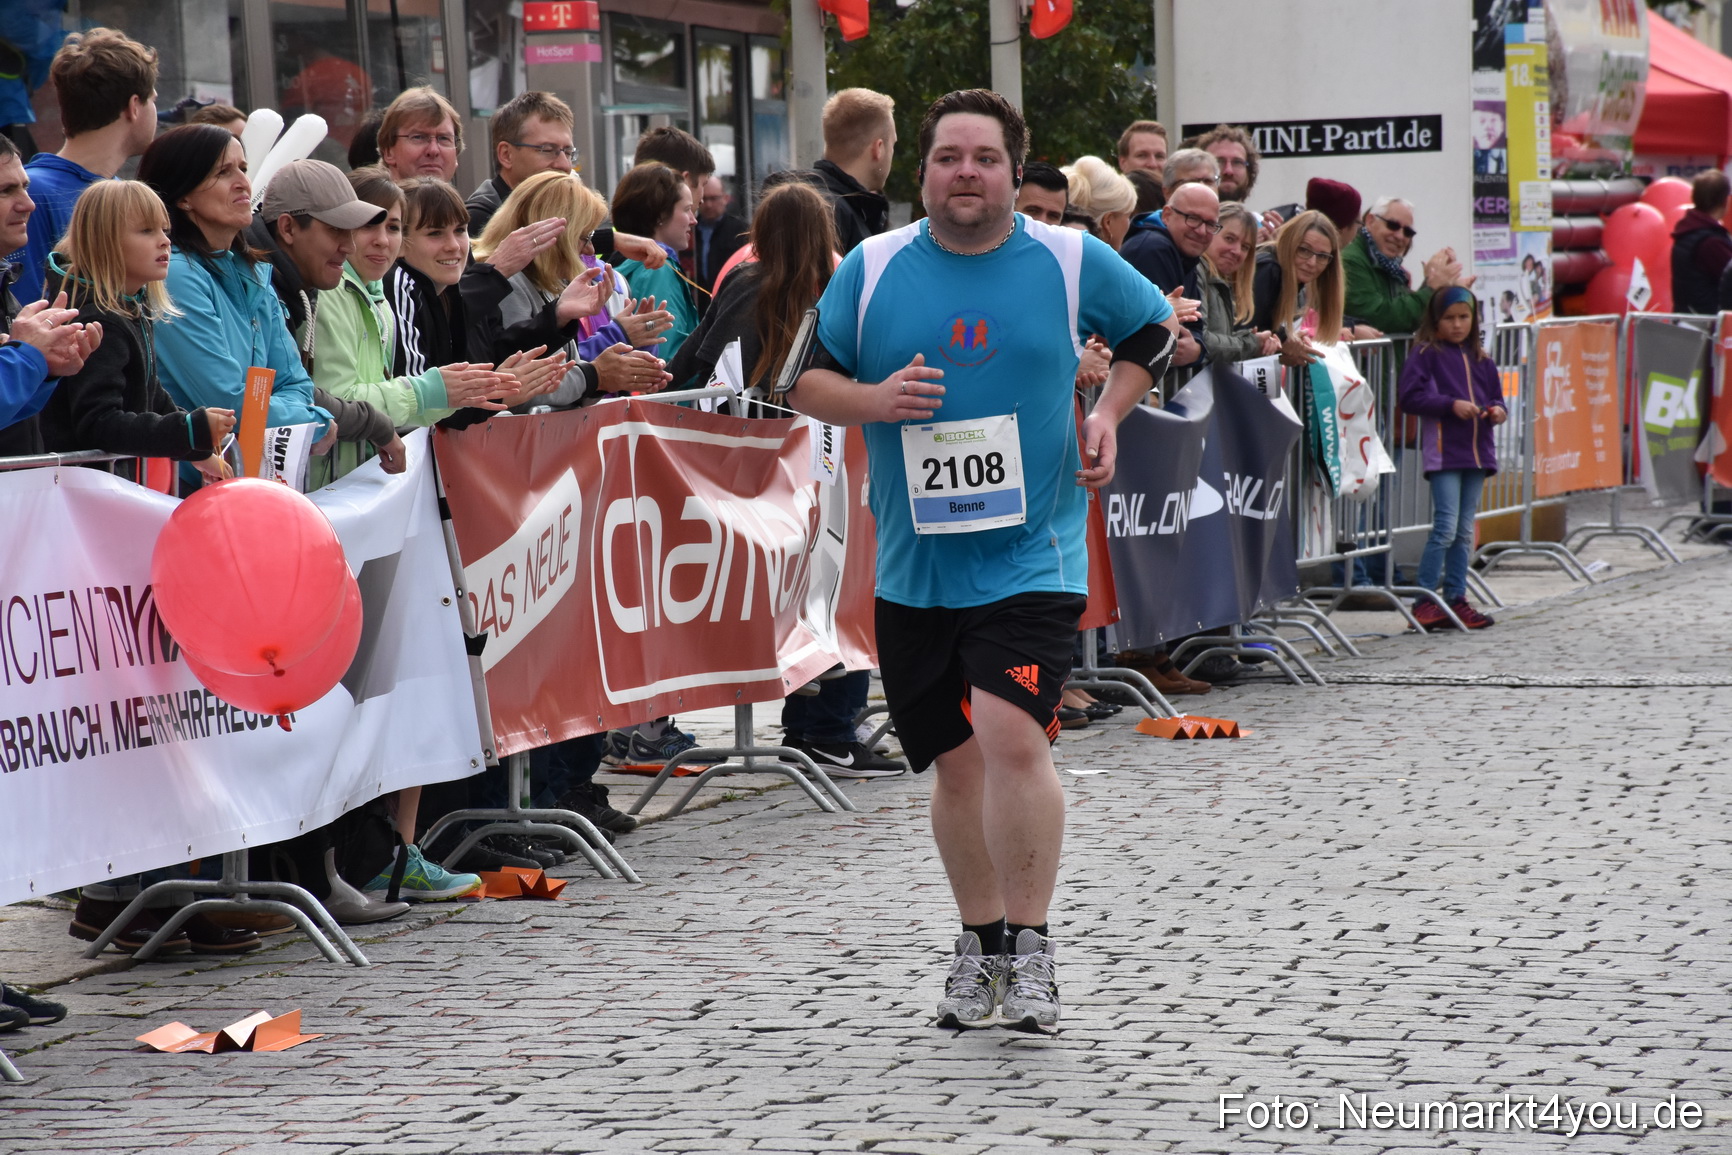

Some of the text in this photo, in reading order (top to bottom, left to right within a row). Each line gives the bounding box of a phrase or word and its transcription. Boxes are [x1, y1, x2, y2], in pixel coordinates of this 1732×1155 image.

[536, 46, 574, 58] HotSpot
[273, 427, 292, 472] swn
[823, 424, 832, 455] wn
[945, 428, 986, 442] BOCK
[922, 451, 1006, 491] 2108
[949, 500, 986, 514] Benne
[1223, 471, 1287, 521] RAIL.O
[523, 503, 572, 614] NEUE
[1004, 667, 1040, 696] adidas
[0, 701, 110, 774] BRAUCH.
